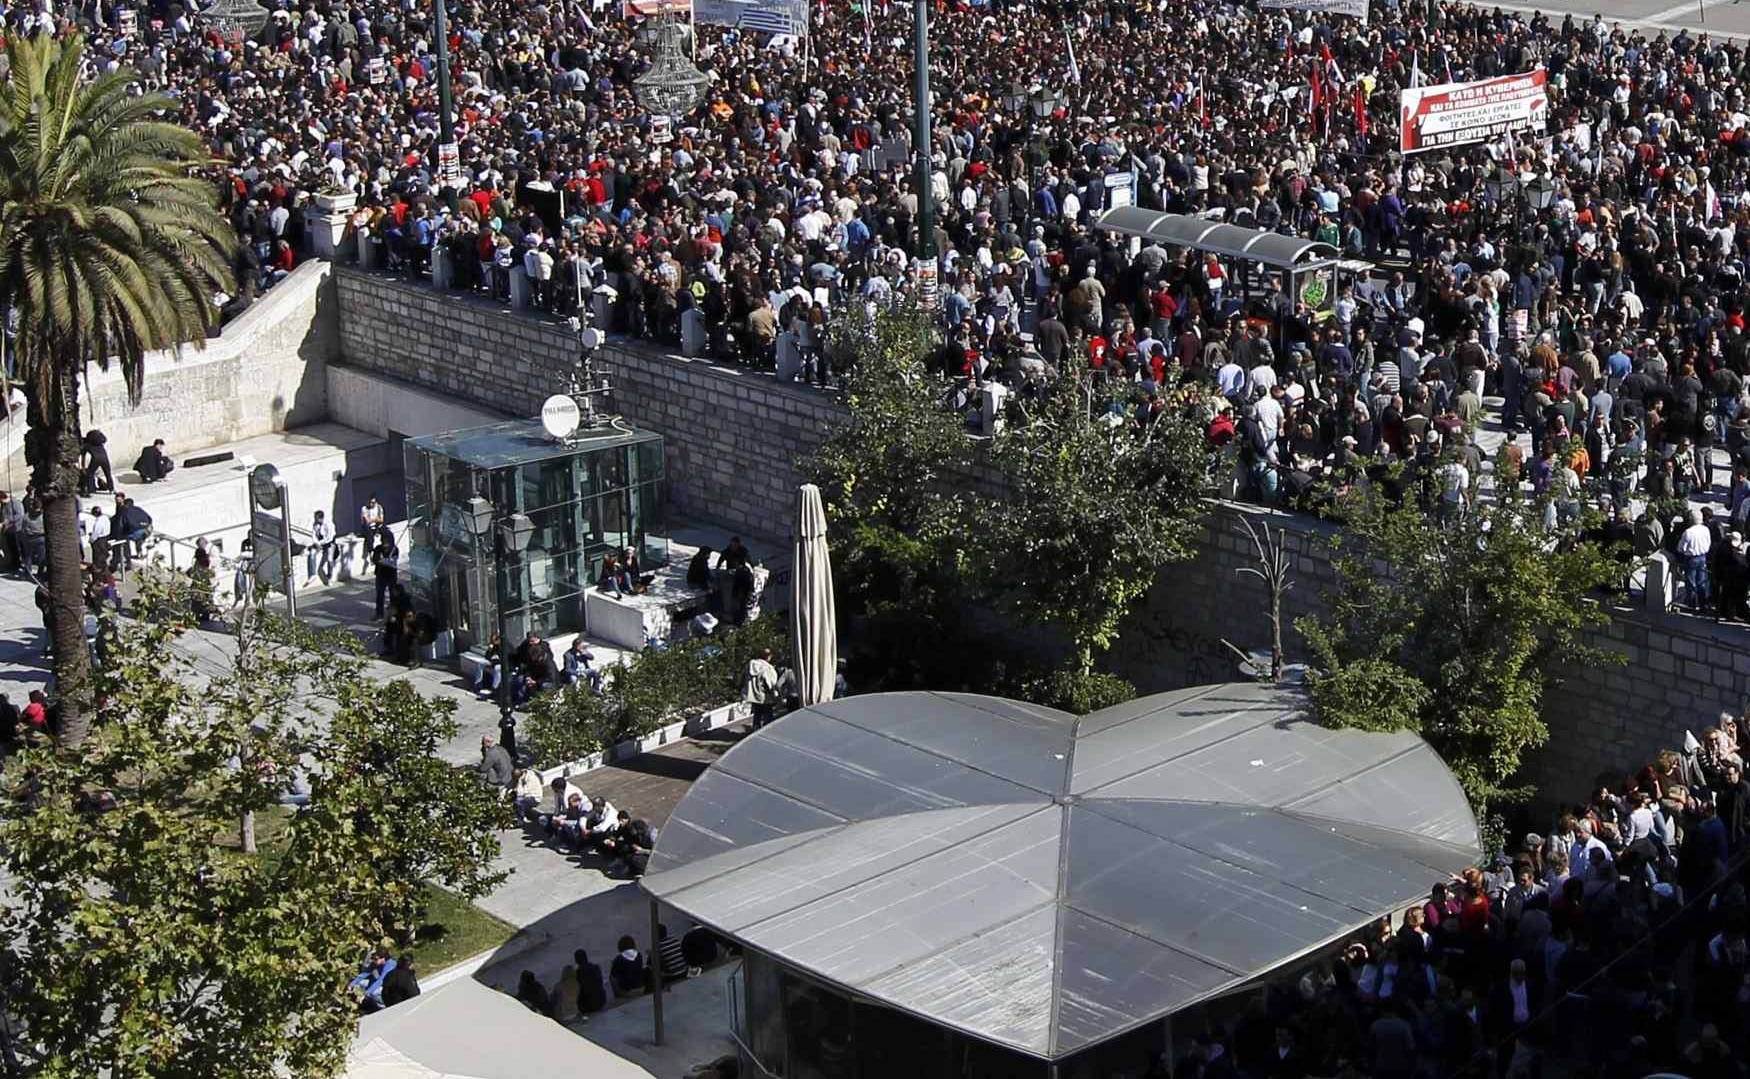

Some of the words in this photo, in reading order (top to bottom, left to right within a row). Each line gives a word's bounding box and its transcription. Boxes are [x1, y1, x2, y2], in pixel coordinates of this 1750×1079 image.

[1448, 86, 1476, 102] ΚΑΤΩ
[1476, 85, 1485, 97] Η
[1430, 102, 1444, 112] ΚΑΙ
[1444, 100, 1455, 111] ΤΑ
[1493, 102, 1521, 113] ΕΡΓΑΤΕΣ
[1422, 133, 1437, 147] ΓΙΑ
[1437, 130, 1455, 144] ΤΗΝ
[1455, 125, 1492, 141] ΕΞΟΥΣΙΑ
[1491, 122, 1506, 136] ΤΟΥ
